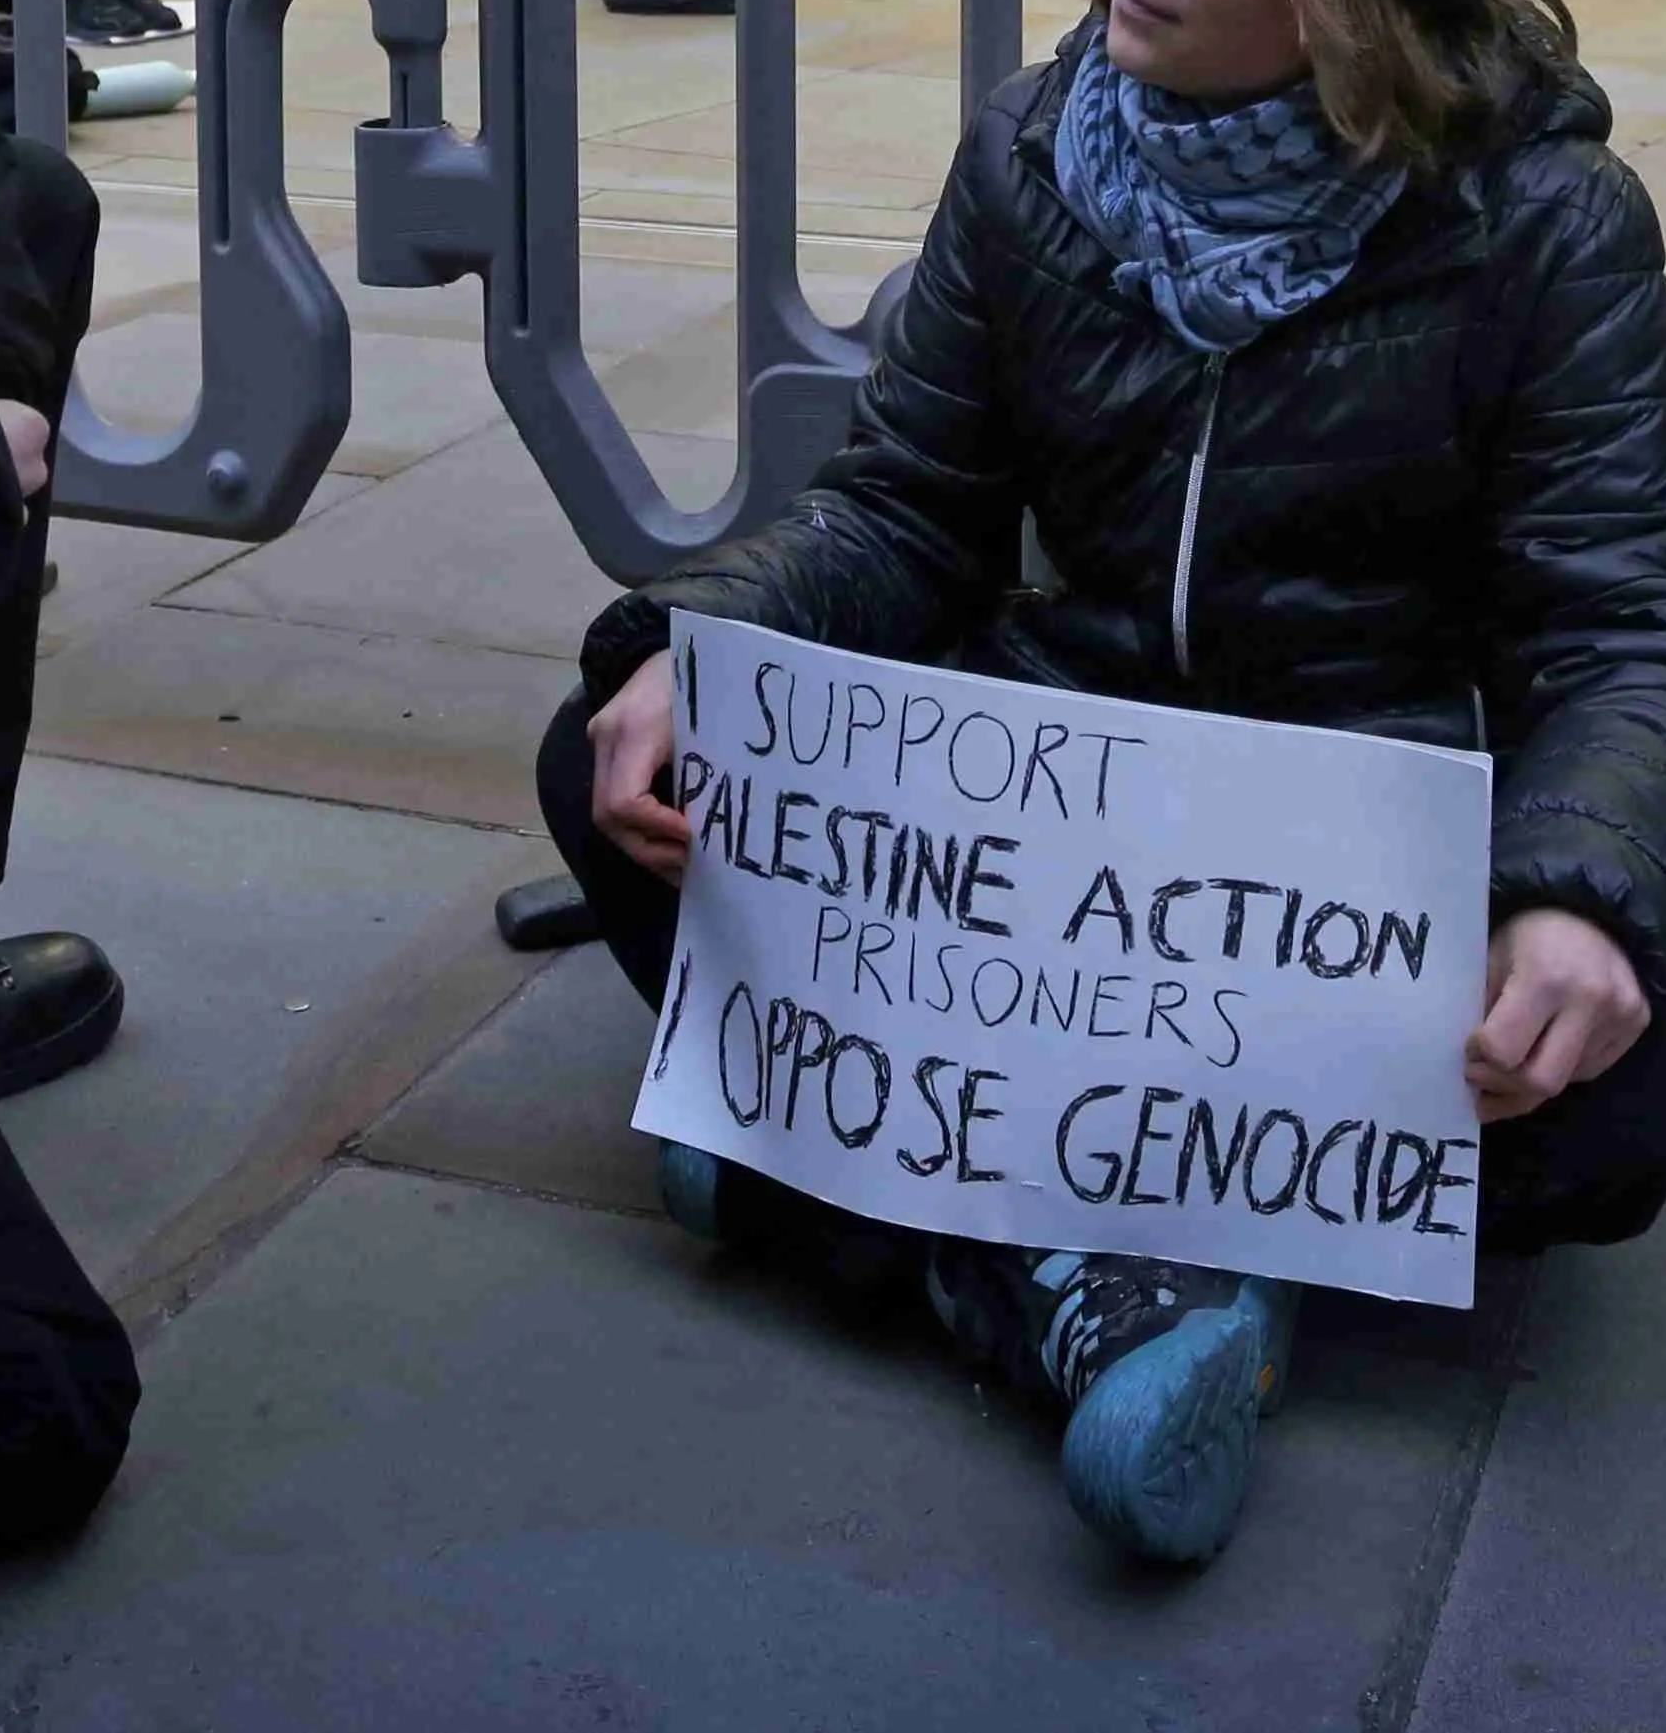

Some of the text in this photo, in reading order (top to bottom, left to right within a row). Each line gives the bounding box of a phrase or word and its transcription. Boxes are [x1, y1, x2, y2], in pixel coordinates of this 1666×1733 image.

[744, 661, 1148, 821] SUPPORT
[677, 751, 1430, 982] PALESTINE ACTION
[812, 904, 1249, 1068] PRISONERS
[718, 981, 1011, 1183] OPPOSE
[1055, 1084, 1478, 1237] GENOCIDE
